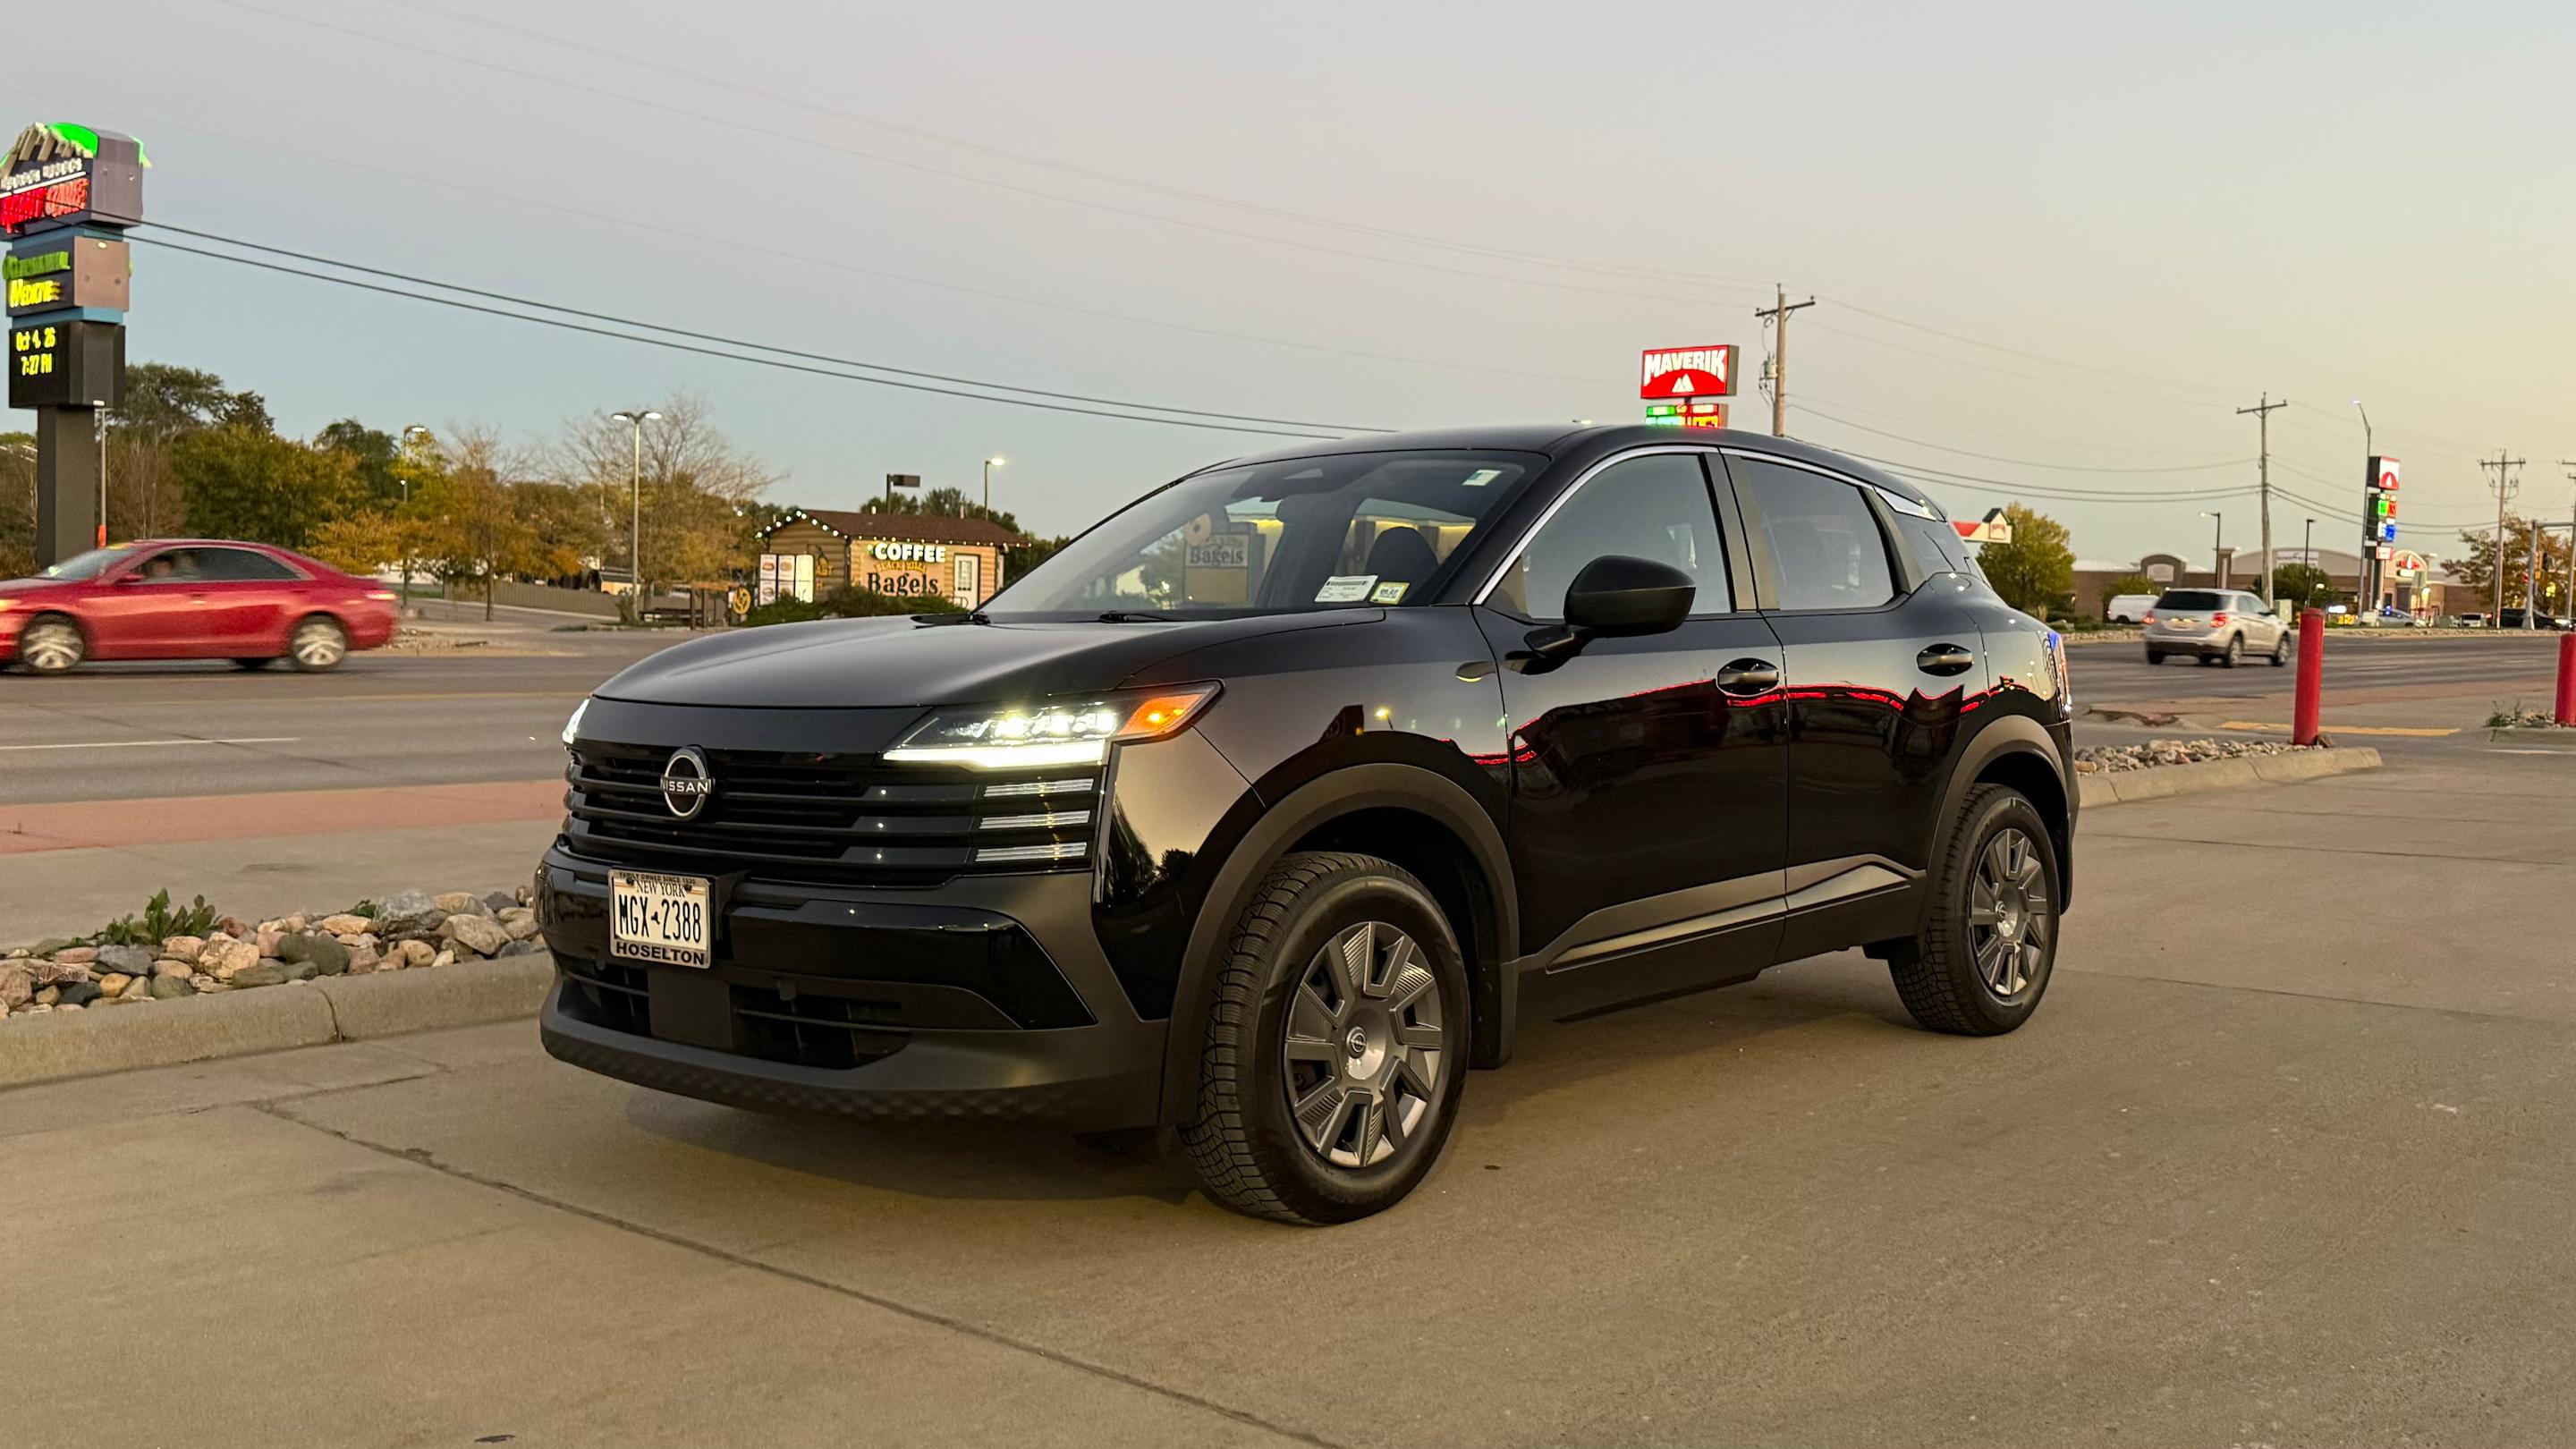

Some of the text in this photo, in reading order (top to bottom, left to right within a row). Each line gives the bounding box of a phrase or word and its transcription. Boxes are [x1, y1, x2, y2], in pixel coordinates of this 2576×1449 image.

[21, 355, 39, 376] 7:27
[1644, 350, 1726, 386] MAVERIK
[875, 543, 945, 563] COFFEE
[1190, 546, 1243, 566] Bagels
[868, 572, 938, 597] Bagels
[636, 880, 685, 897] NEW YORK
[616, 942, 705, 965] HOSELTON
